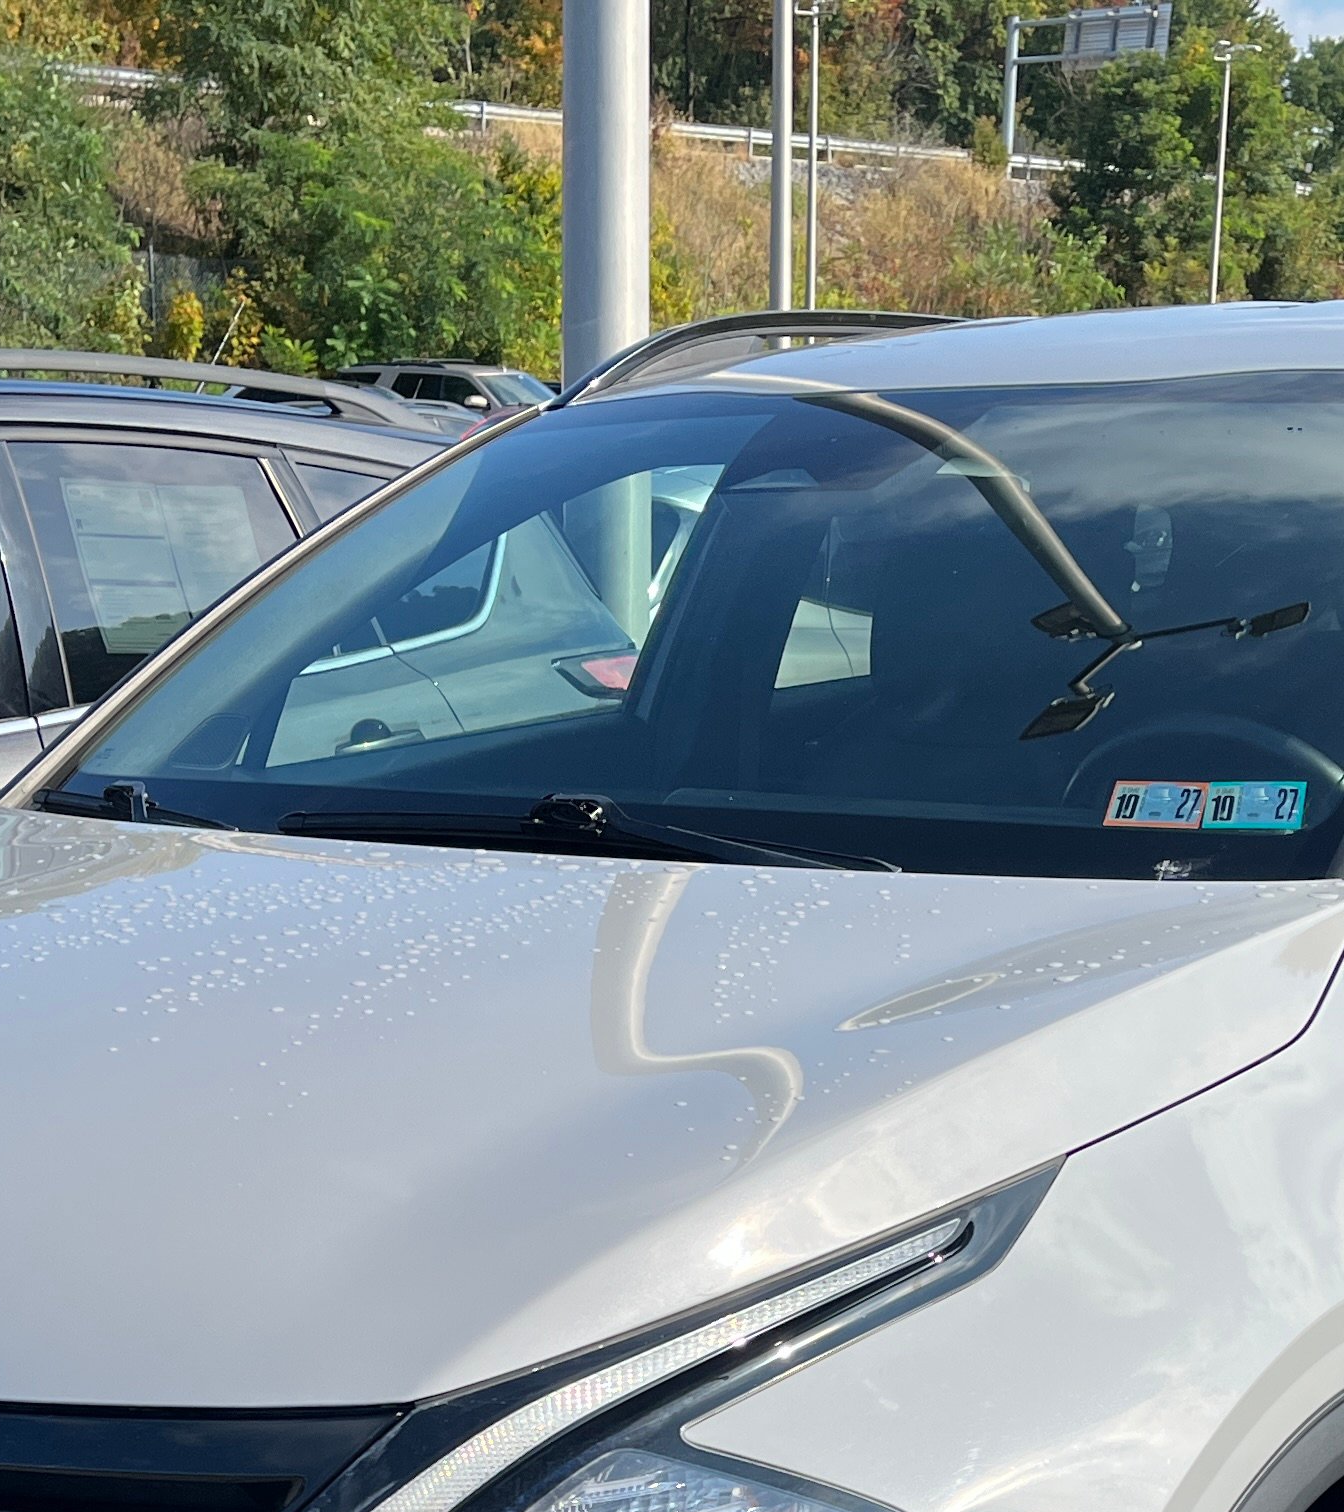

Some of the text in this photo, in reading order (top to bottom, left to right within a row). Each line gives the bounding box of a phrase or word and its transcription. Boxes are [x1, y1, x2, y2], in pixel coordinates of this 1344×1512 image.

[1114, 788, 1202, 822] 10 27
[1211, 788, 1299, 822] 10 27
